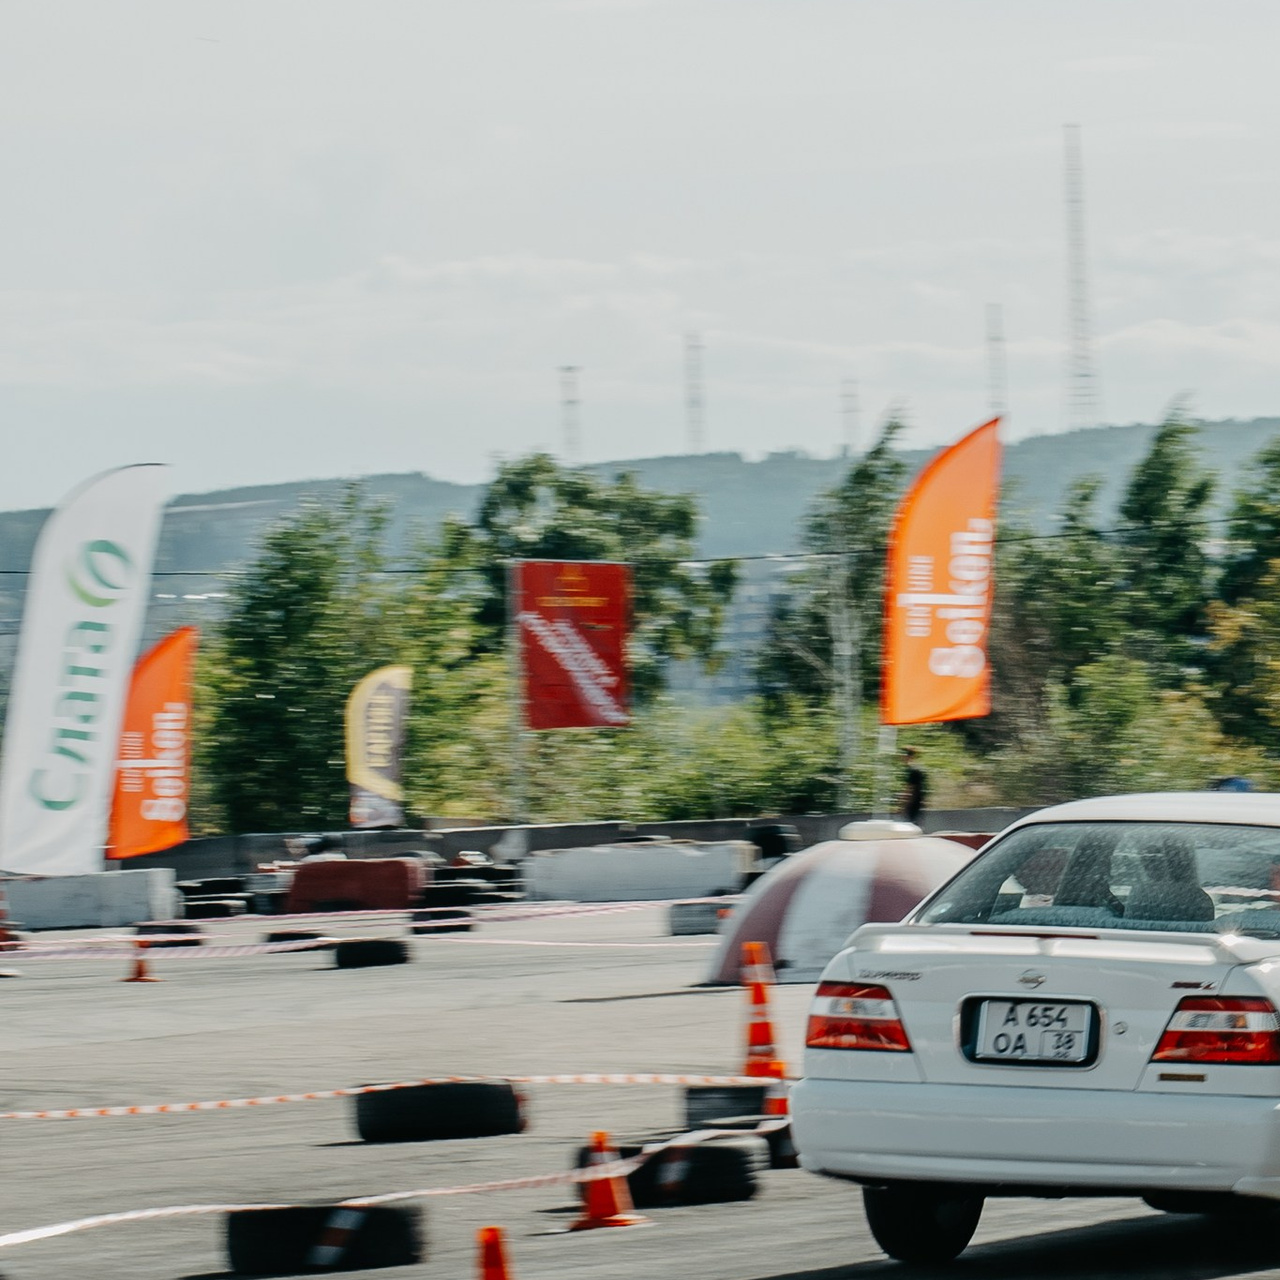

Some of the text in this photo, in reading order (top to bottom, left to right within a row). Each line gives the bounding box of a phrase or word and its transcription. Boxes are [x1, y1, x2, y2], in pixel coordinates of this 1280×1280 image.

[28, 620, 112, 811] Слата
[1026, 1005, 1068, 1028] 654
[1052, 1032, 1076, 1050] 38
